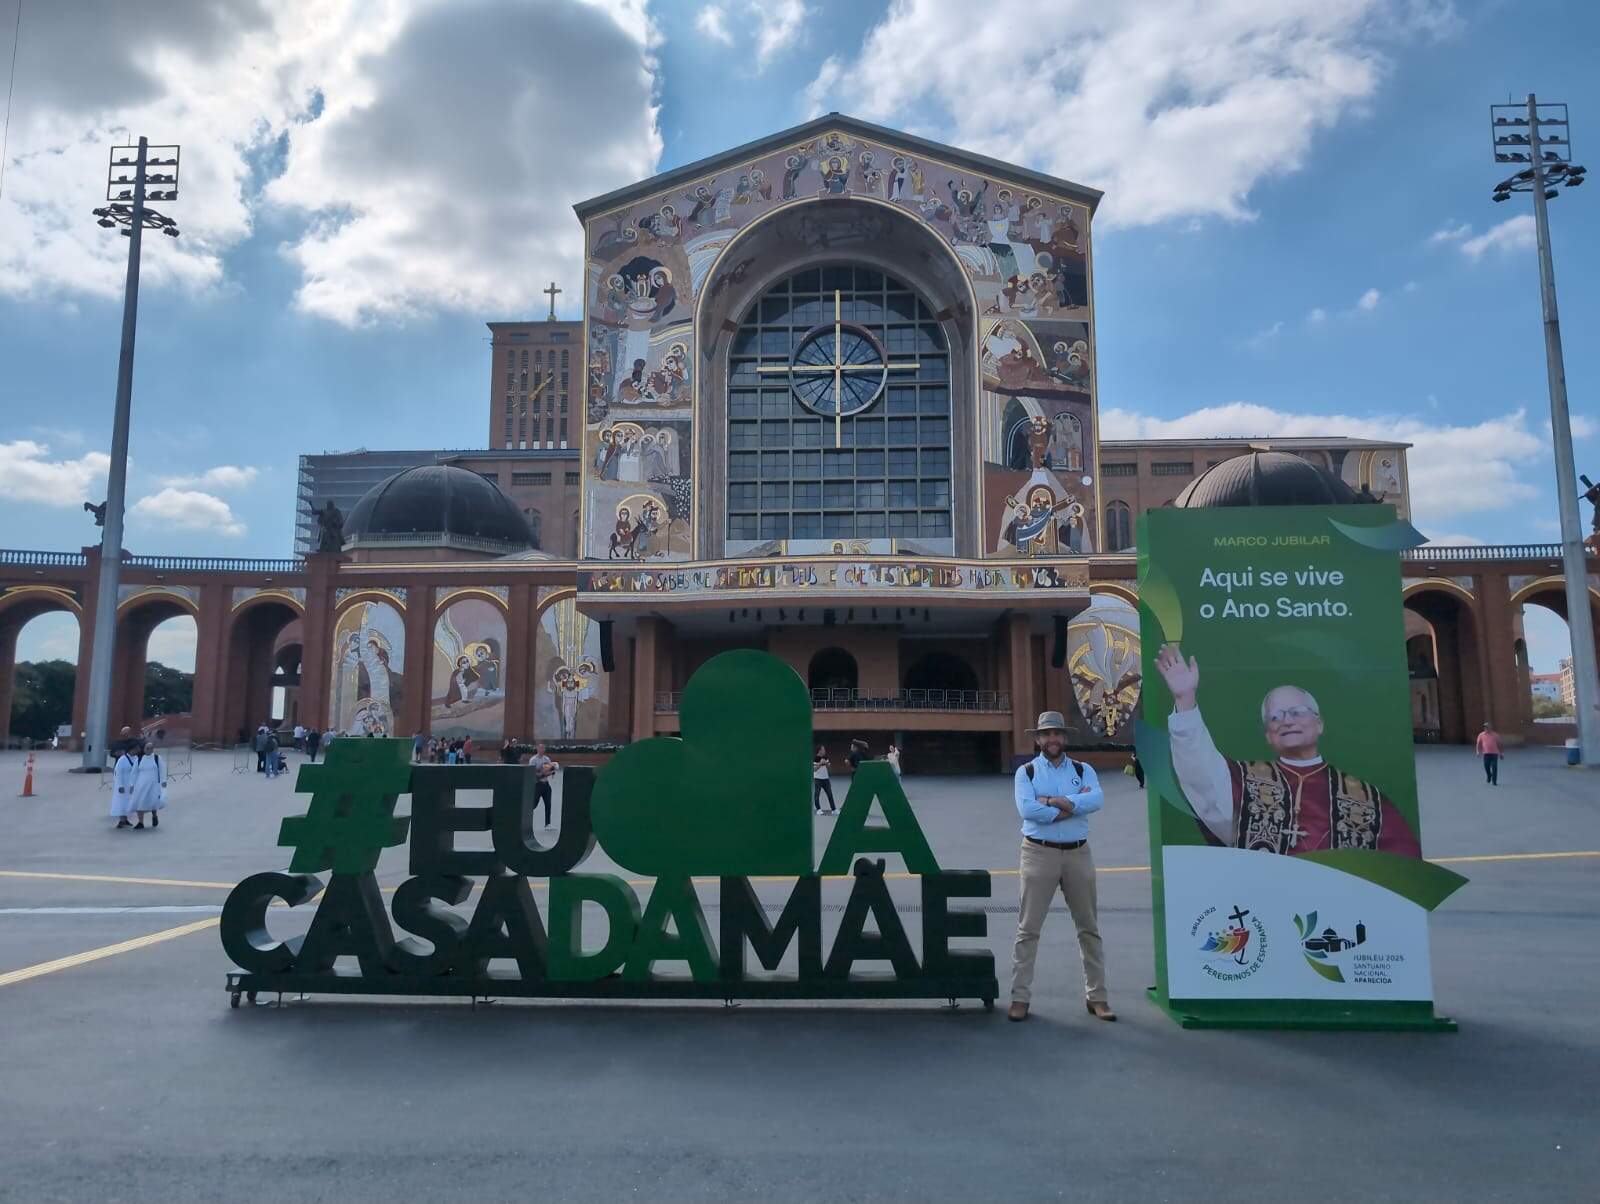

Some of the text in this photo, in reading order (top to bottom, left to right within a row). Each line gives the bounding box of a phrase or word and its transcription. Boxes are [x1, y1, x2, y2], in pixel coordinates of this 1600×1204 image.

[1214, 535, 1330, 547] MARCO JUBILAR
[1200, 565, 1344, 592] Aqui se vive
[1200, 597, 1353, 619] o Ano Santo.
[1386, 954, 1404, 962] 2025
[1203, 964, 1251, 982] PEREGRINOS
[1250, 961, 1261, 973] DE
